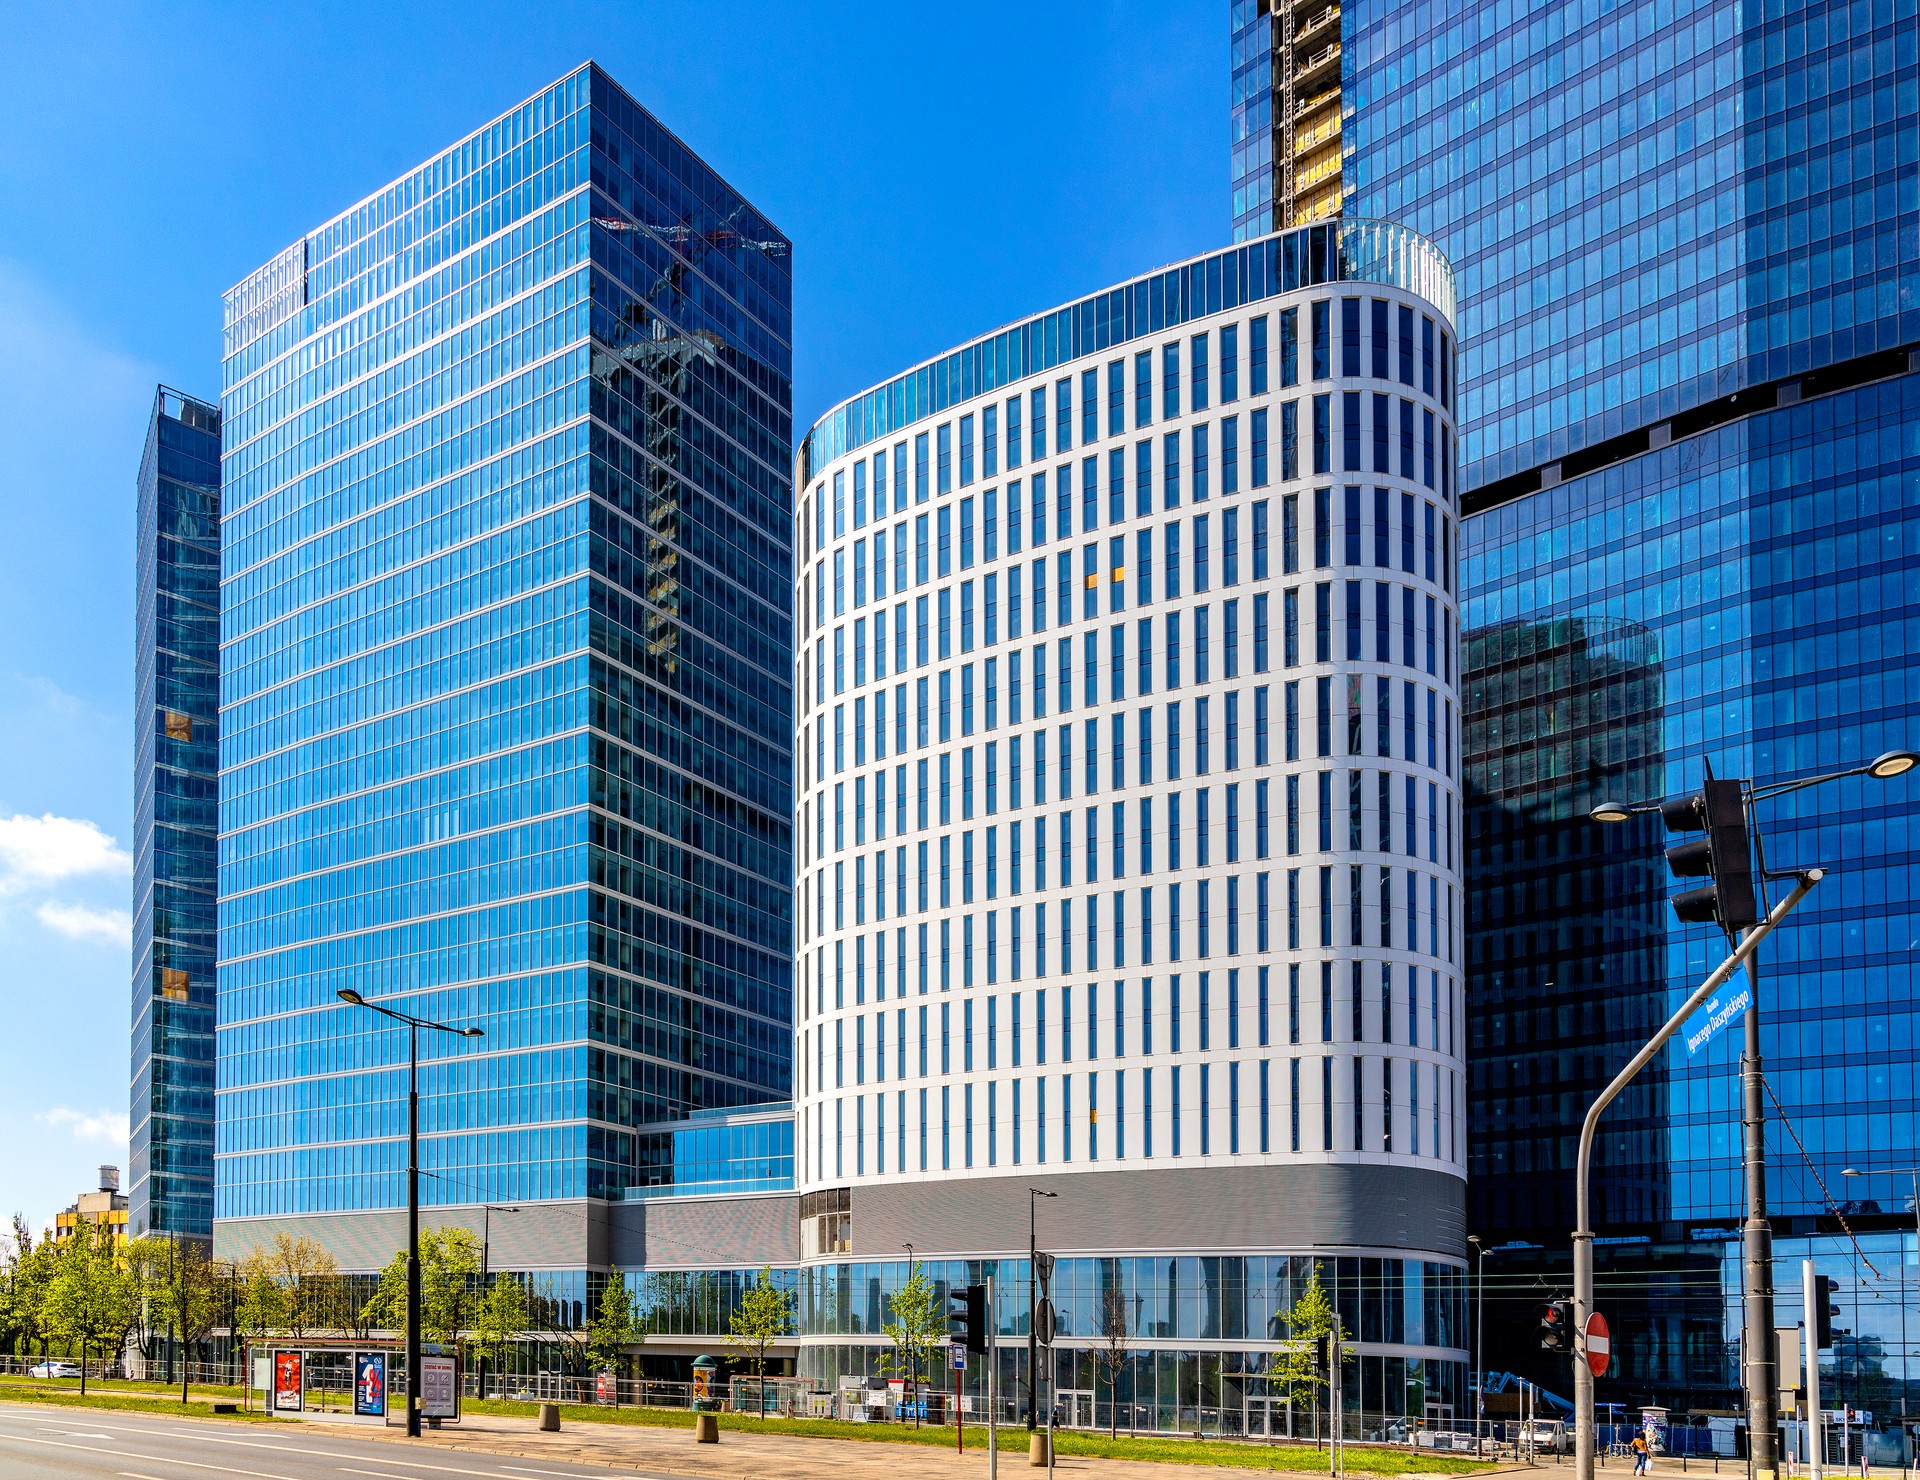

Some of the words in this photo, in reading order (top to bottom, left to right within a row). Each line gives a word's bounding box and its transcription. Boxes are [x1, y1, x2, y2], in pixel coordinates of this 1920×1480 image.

[1687, 1024, 1711, 1053] Ignacego
[1710, 991, 1749, 1031] Daszyńskiego
[1706, 998, 1719, 1014] Rondo
